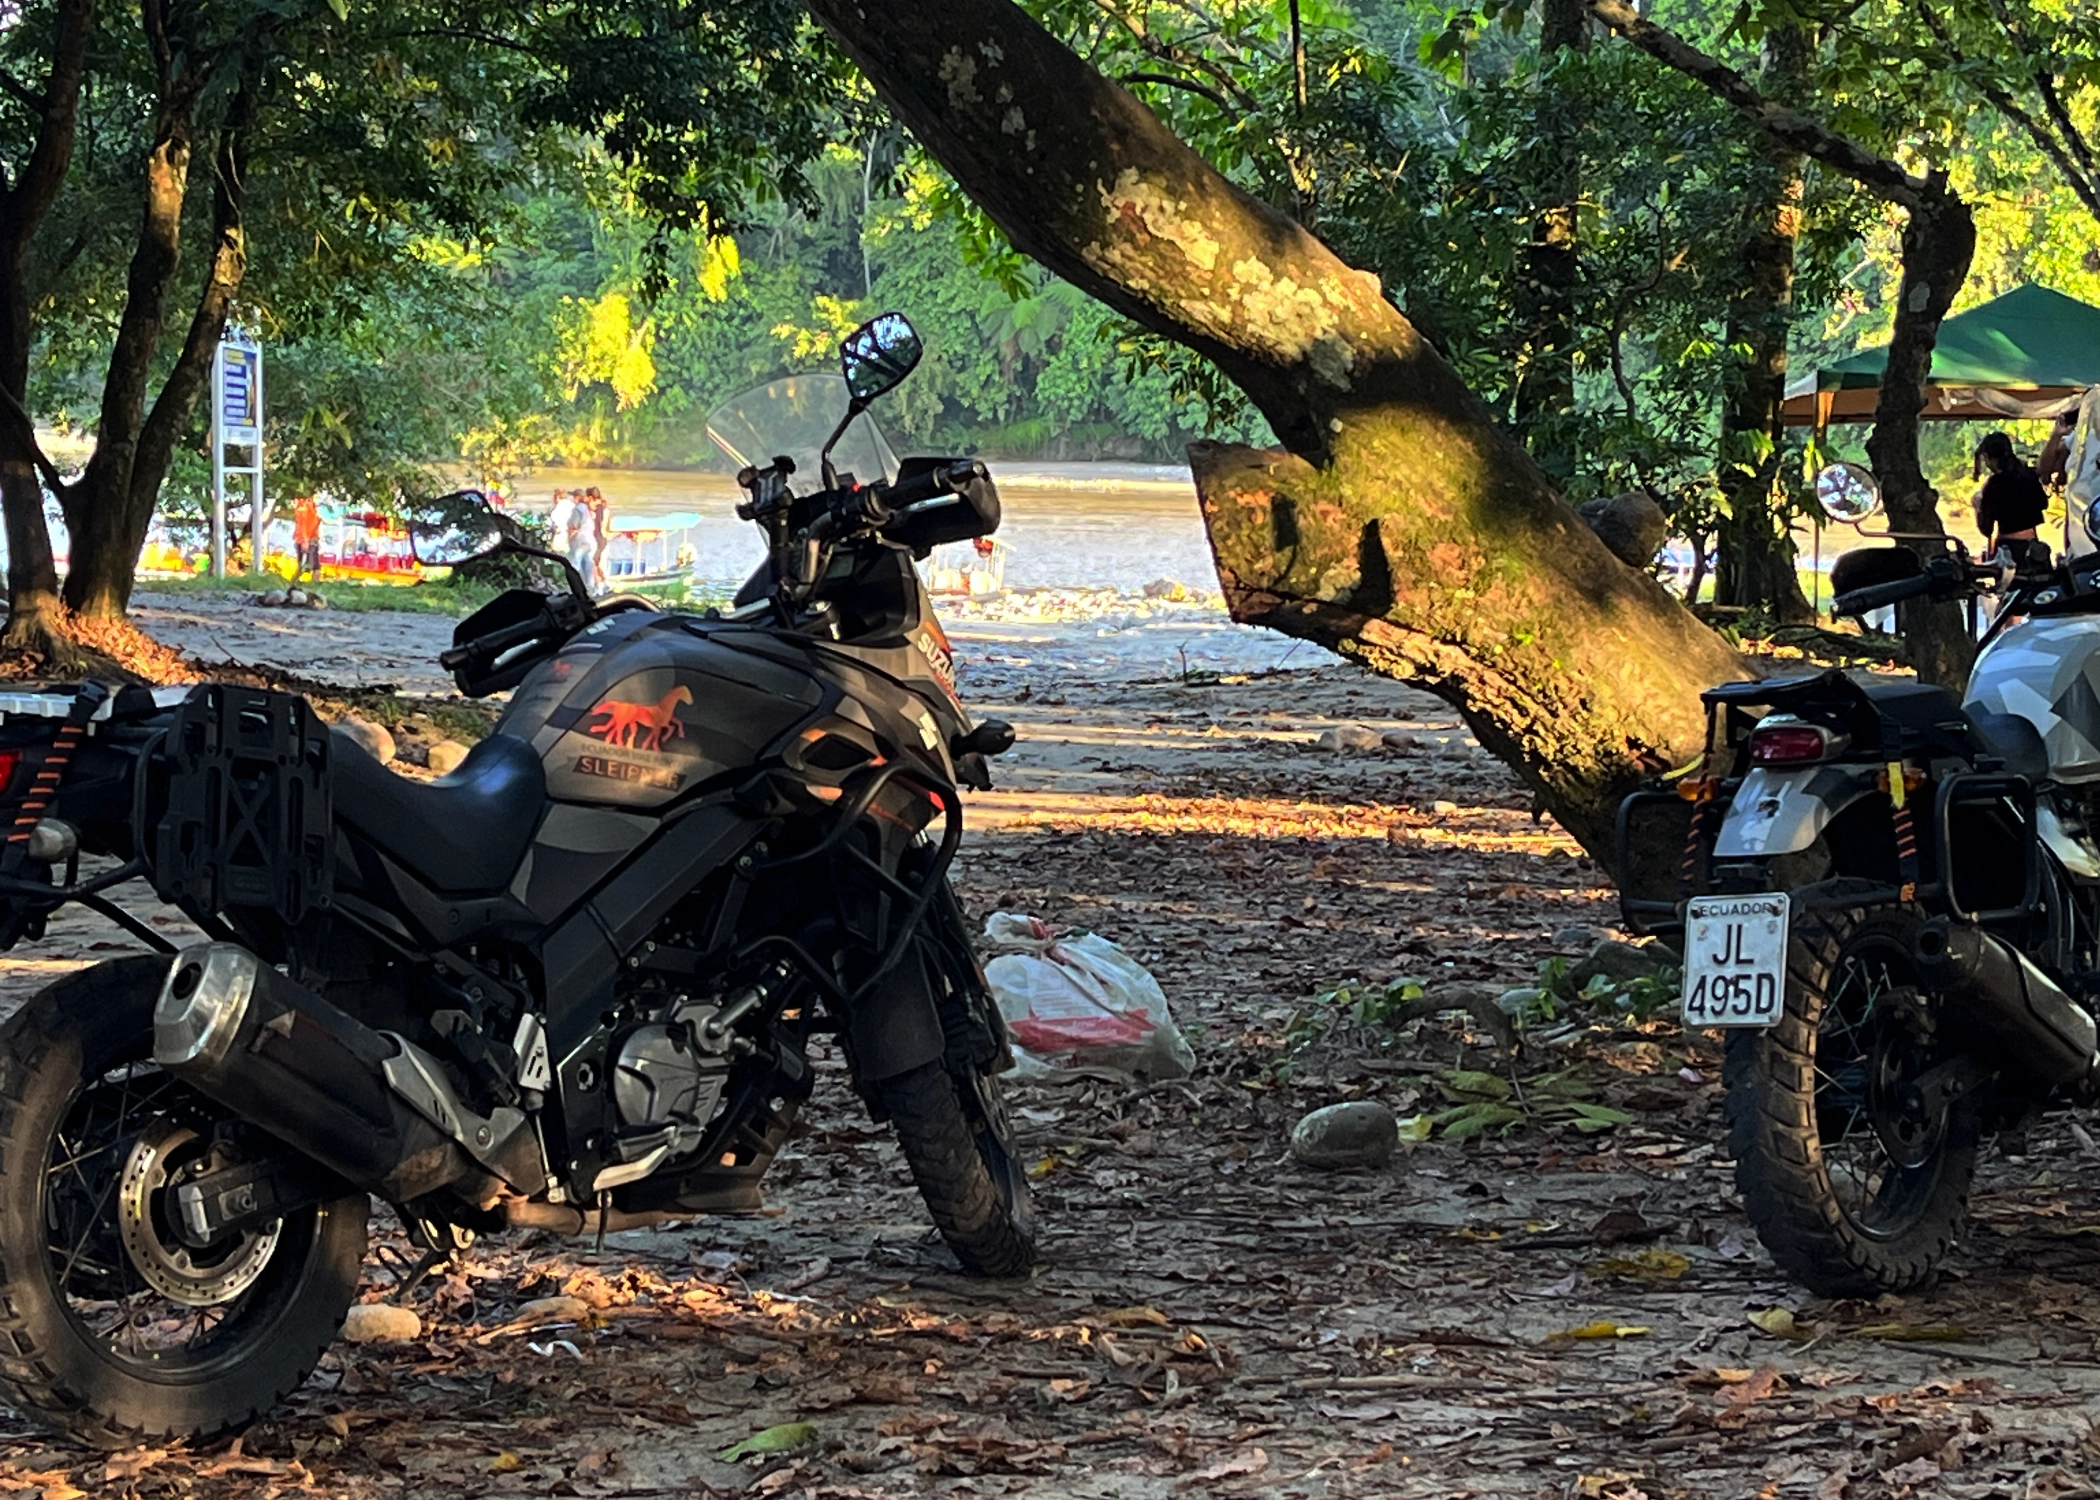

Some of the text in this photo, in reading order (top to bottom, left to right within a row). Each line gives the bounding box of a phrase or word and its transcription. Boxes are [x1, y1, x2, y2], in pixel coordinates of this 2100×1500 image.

[917, 632, 955, 687] SUZU
[1701, 902, 1773, 917] ECUADOR
[1712, 924, 1754, 965] JL
[1687, 972, 1776, 1017] 495D
